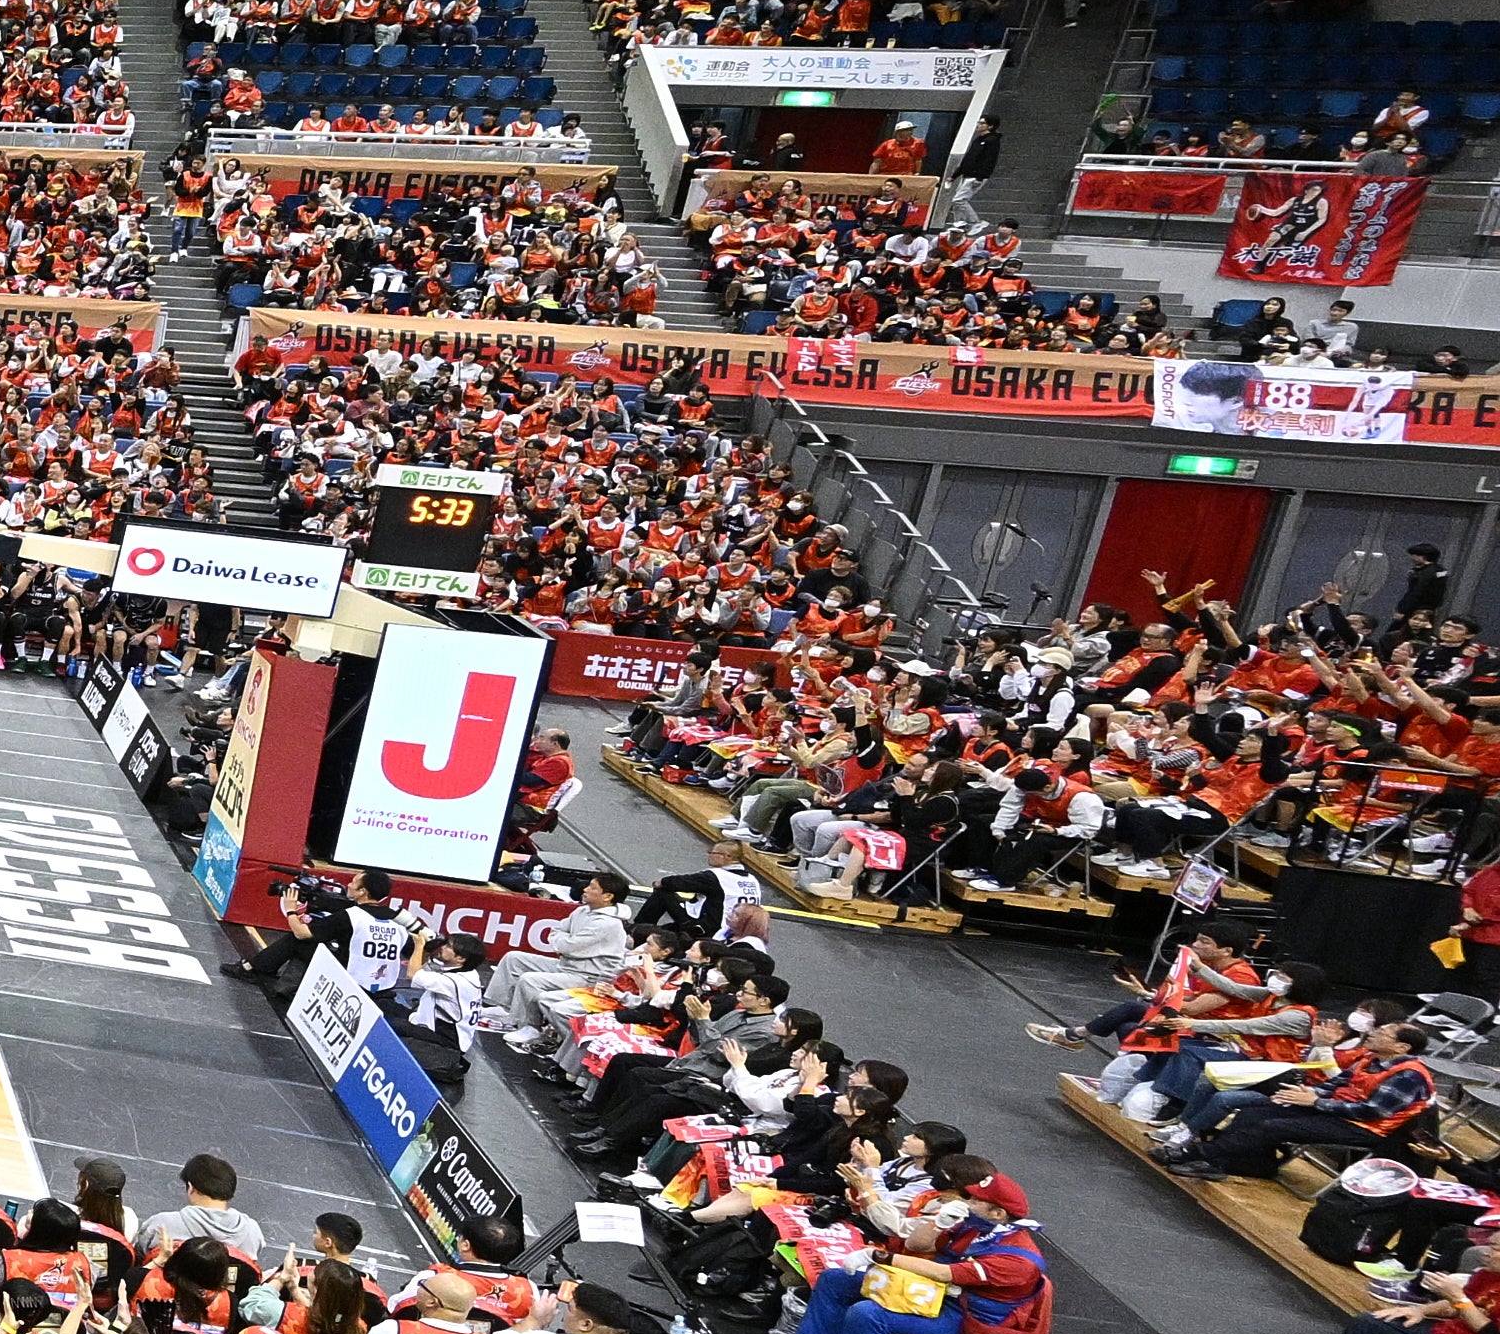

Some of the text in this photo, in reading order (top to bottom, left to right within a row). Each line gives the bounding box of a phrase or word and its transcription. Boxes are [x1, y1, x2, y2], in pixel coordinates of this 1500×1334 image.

[706, 56, 871, 71] 運動会 大人の運動会
[763, 71, 922, 85] プロデュースします。
[951, 365, 1073, 402] OSAKA
[1162, 365, 1176, 420] DOGFIGHT
[1265, 383, 1312, 409] 88
[1237, 409, 1336, 436] 牧隼利
[422, 473, 484, 491] たけでん
[409, 495, 474, 527] 5:33
[391, 570, 477, 596] たけでん
[381, 671, 517, 799] J
[355, 807, 430, 823] ジェイ・ライン株式会社
[353, 815, 489, 842] J-line Corporation
[369, 925, 397, 938] BROAD
[372, 932, 394, 943] CAST
[363, 942, 398, 961] 028
[303, 992, 352, 1059] シャーリング
[352, 1045, 416, 1138] FIGARO
[448, 1152, 497, 1217] Captain
